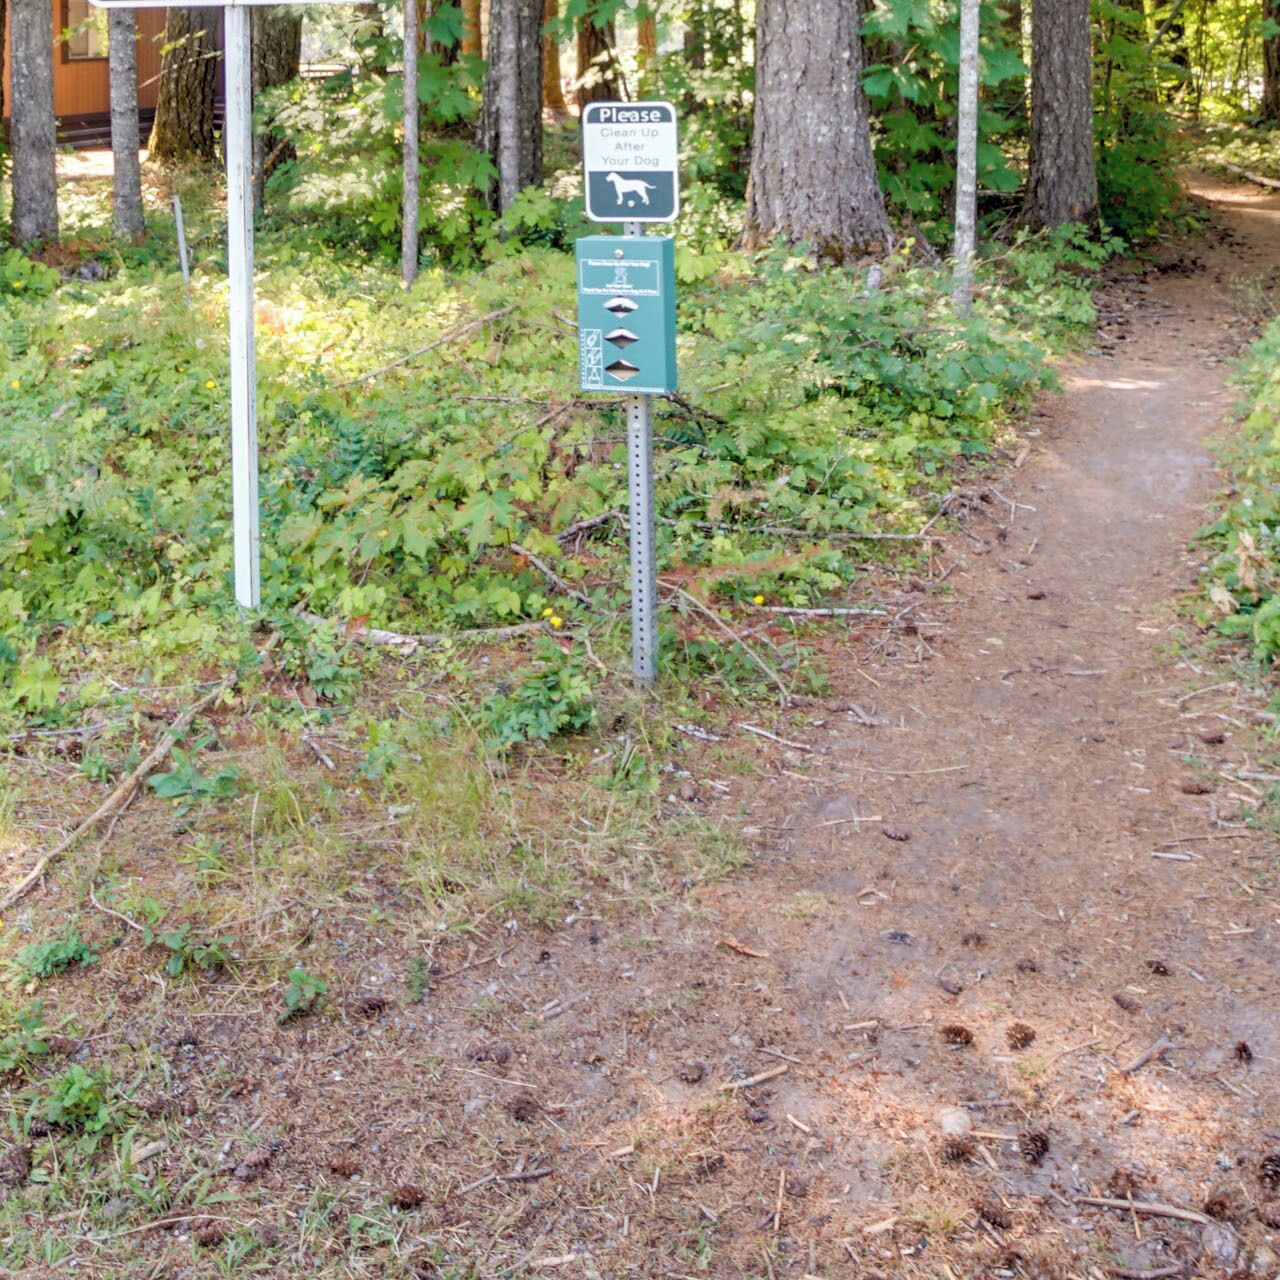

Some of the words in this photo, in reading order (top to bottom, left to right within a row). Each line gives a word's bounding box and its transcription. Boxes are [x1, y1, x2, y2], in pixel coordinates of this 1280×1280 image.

[599, 107, 661, 123] Please
[600, 127, 636, 138] Clean
[641, 127, 659, 139] Up
[614, 142, 645, 151] After
[601, 156, 629, 166] Your
[634, 156, 660, 167] Dog
